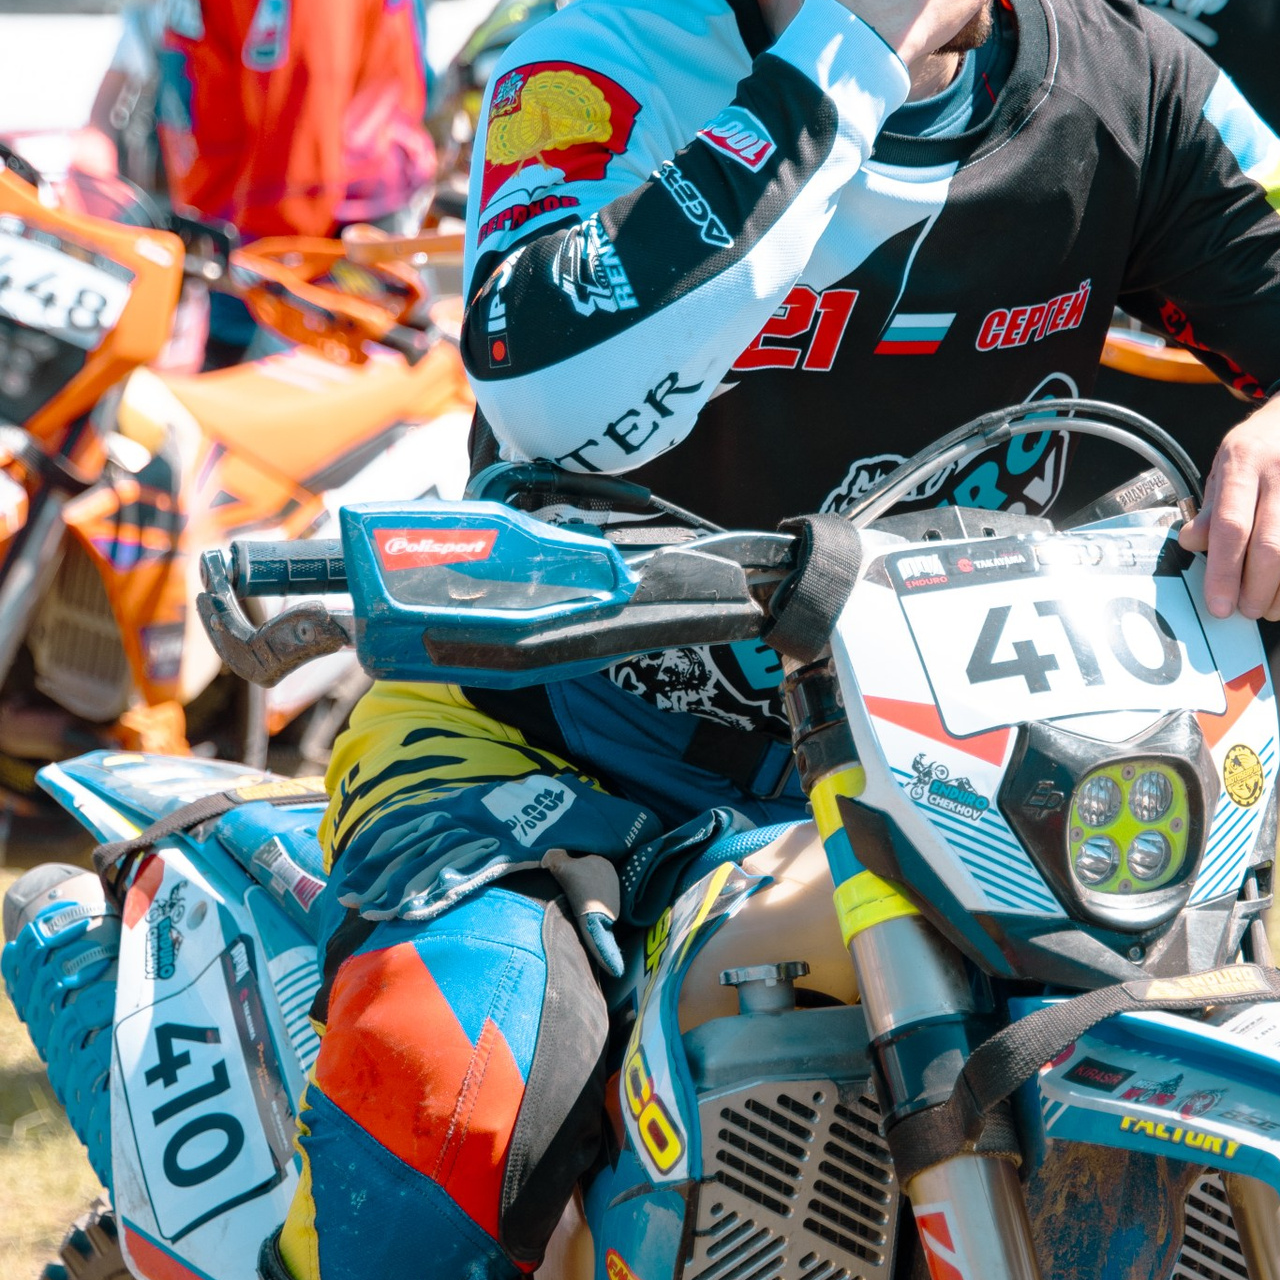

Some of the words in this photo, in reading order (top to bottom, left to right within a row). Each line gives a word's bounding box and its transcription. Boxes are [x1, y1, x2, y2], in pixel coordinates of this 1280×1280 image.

[976, 279, 1092, 351] СЕРГЕЙ
[385, 536, 488, 558] Polisport
[972, 552, 1027, 571] TAKAYAMA
[905, 575, 948, 589] ENDURO
[965, 596, 1184, 695] 410
[927, 793, 983, 822] CHEKHOV
[930, 780, 989, 812] ENDURO
[145, 1021, 245, 1189] 410
